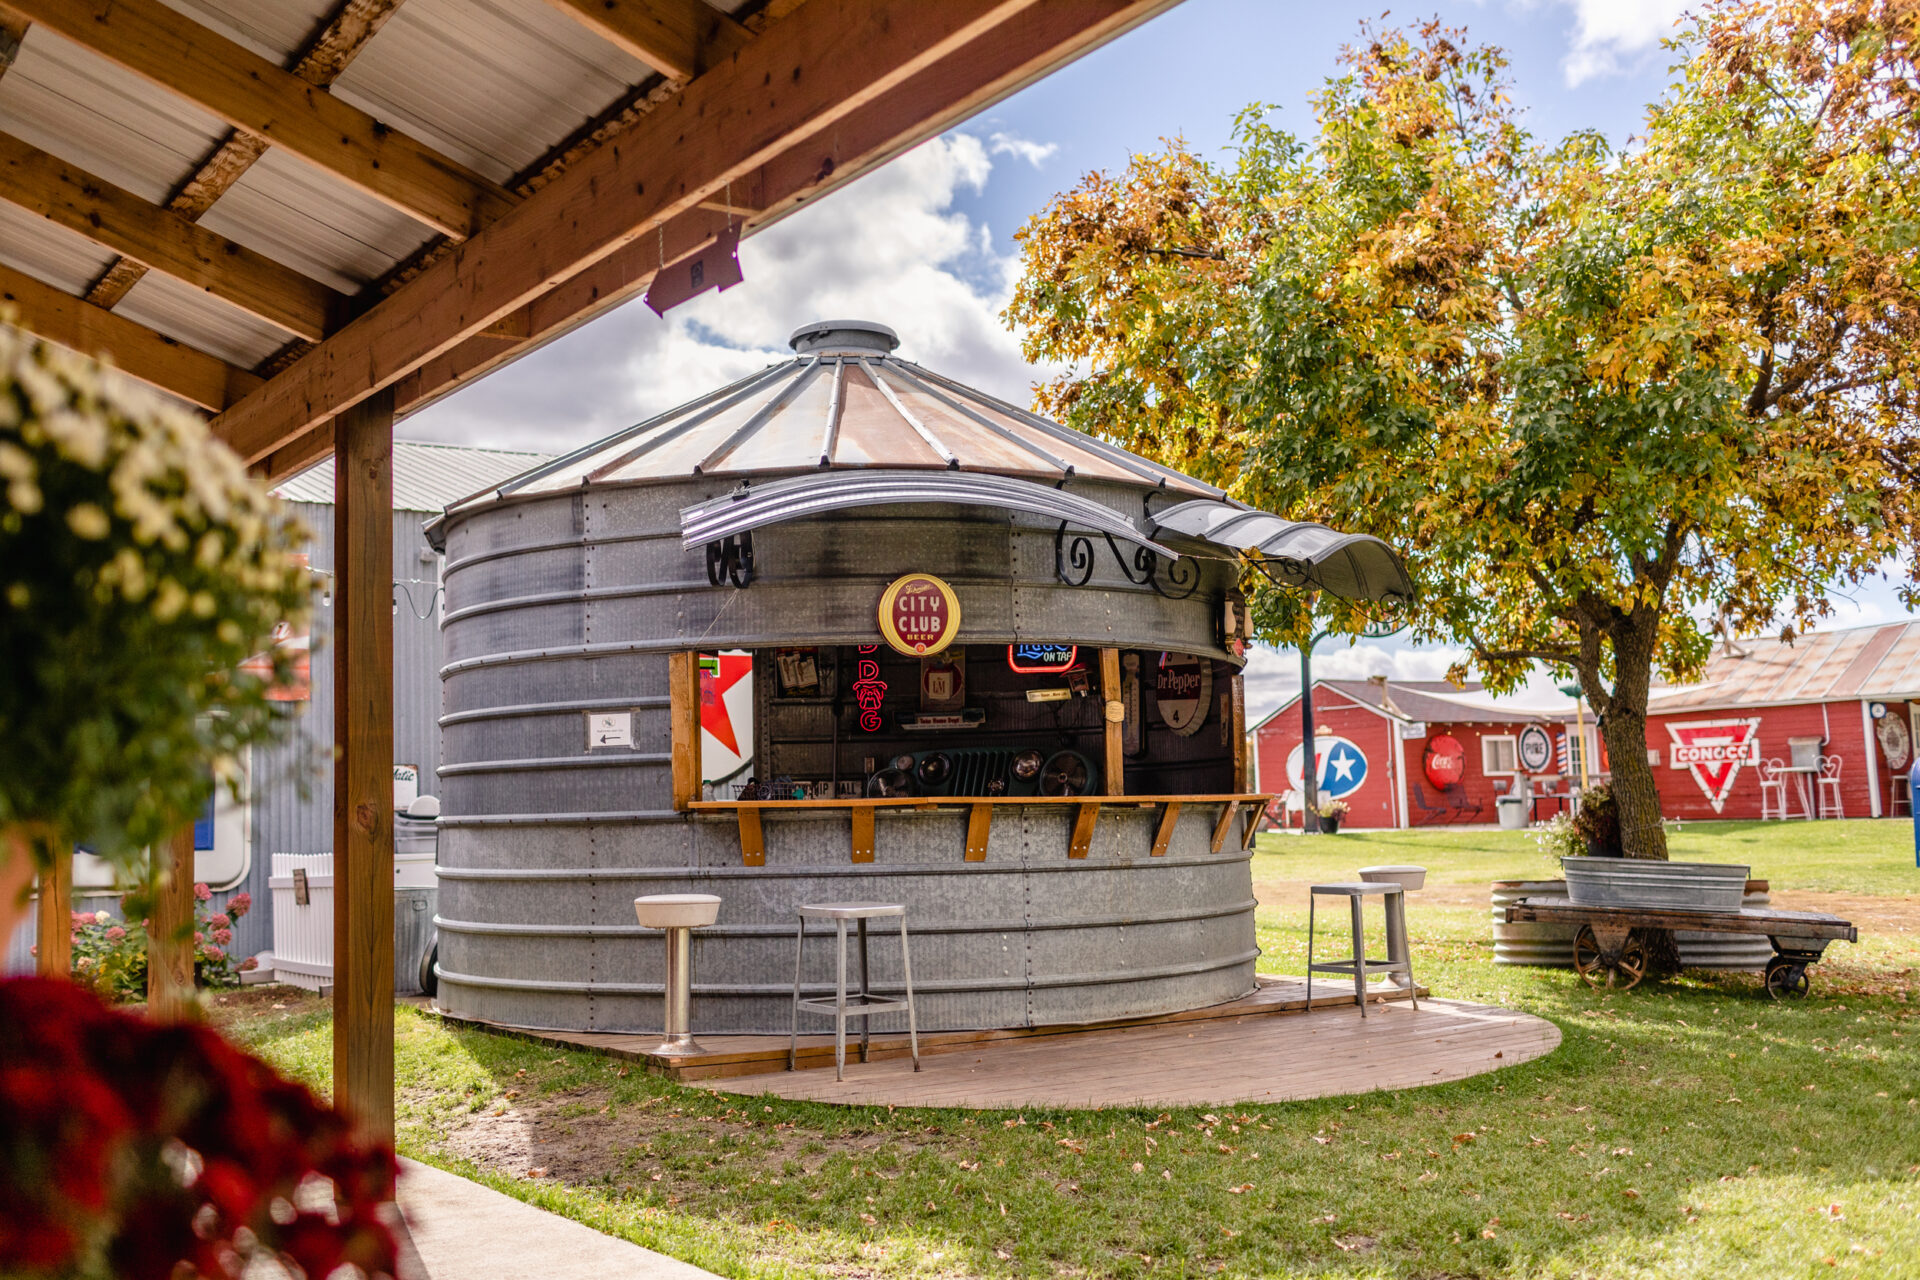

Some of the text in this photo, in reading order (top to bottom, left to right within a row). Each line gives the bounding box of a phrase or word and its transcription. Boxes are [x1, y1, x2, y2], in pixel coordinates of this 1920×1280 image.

[899, 596, 940, 612] CITY
[898, 616, 940, 632] CLUB
[1043, 651, 1072, 662] ON TAP
[1157, 669, 1200, 695] Dr Pepper
[1173, 710, 1180, 723] 4
[1678, 745, 1748, 762] CONOCO
